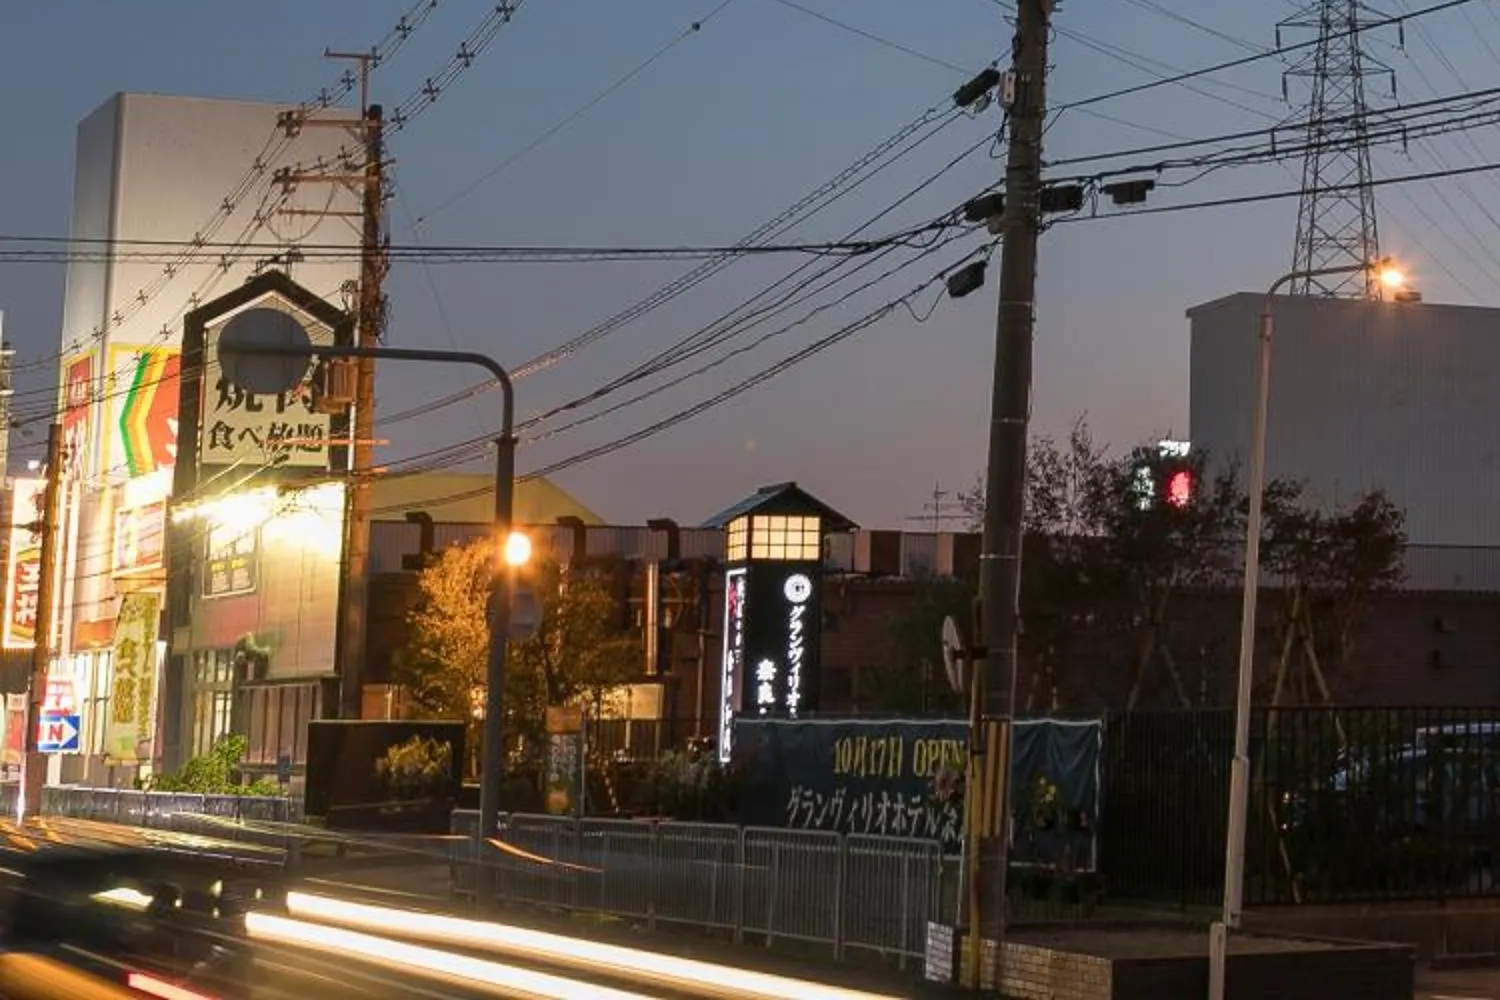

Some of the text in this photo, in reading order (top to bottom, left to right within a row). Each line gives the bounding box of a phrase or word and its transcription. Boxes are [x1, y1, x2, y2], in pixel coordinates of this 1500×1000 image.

[786, 605, 806, 718] グランヴィリオ
